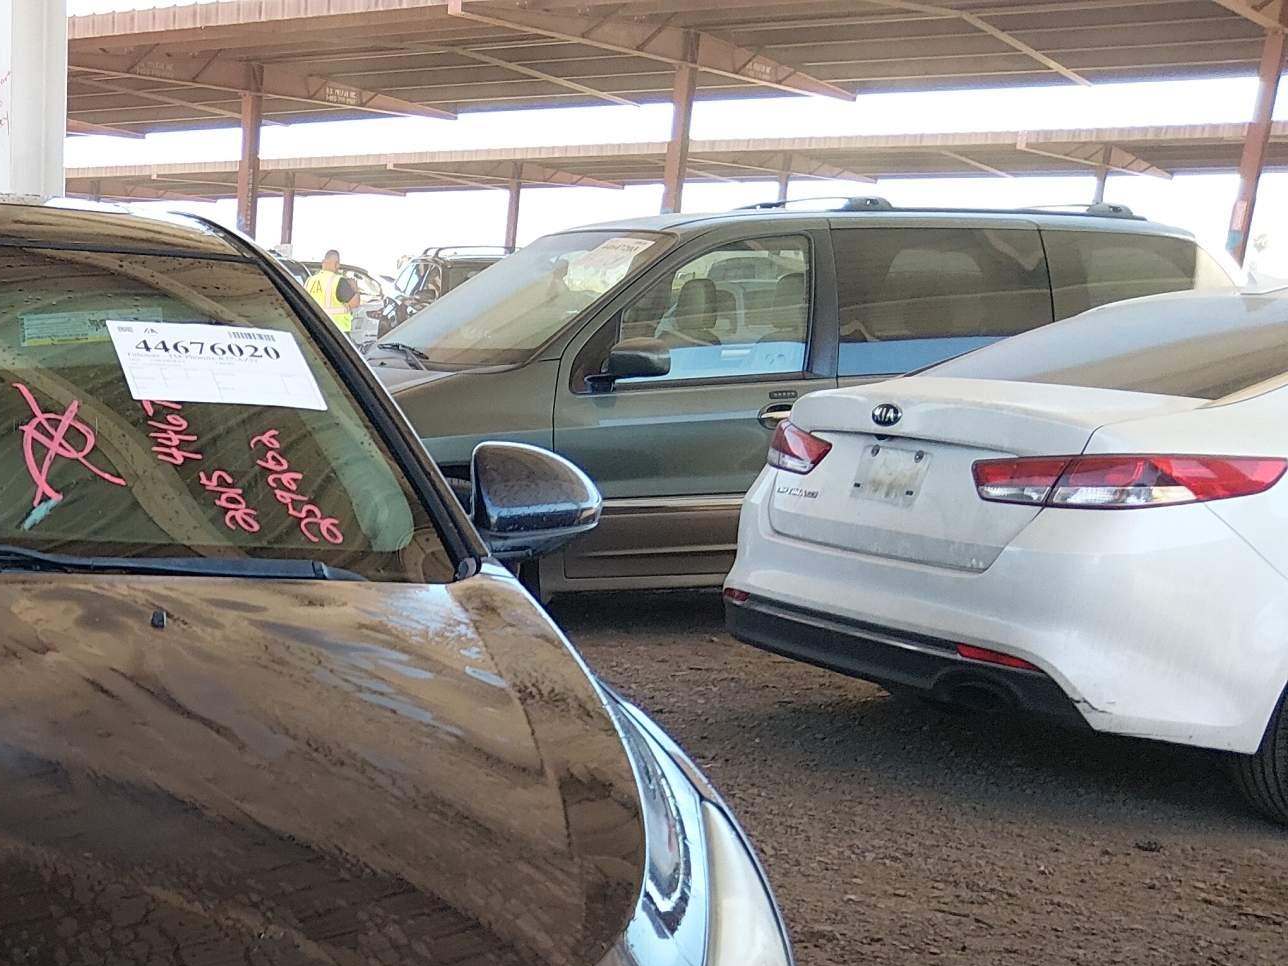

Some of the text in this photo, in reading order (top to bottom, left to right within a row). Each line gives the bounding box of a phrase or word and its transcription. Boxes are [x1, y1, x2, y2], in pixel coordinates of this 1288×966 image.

[135, 338, 281, 361] 44676020
[199, 469, 261, 533] 2015
[249, 429, 344, 545] 259262
